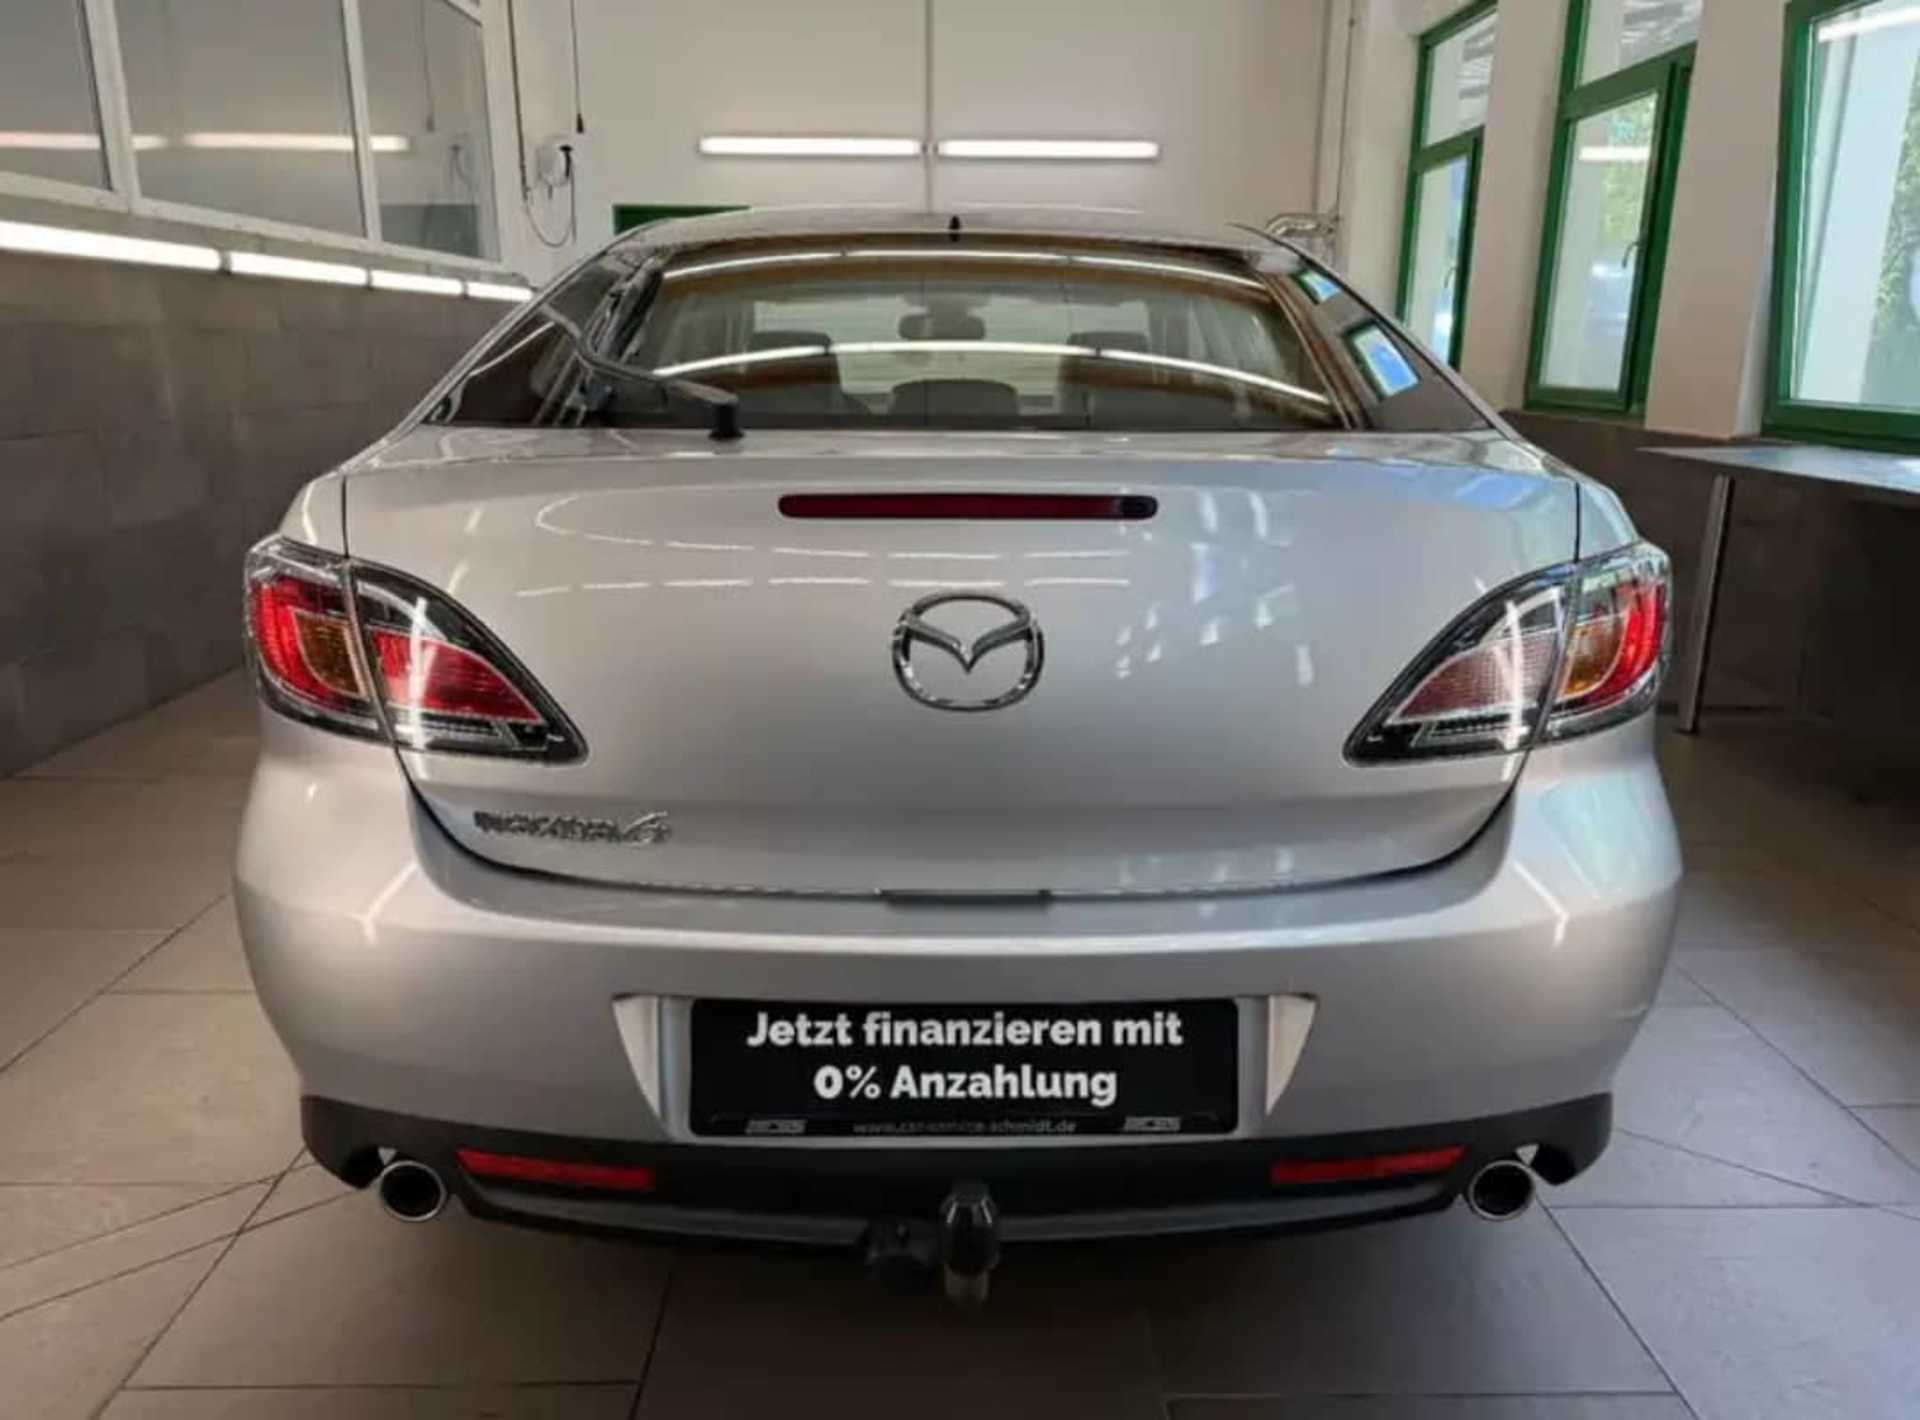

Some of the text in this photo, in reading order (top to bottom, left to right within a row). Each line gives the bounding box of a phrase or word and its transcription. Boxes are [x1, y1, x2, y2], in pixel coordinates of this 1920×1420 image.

[746, 1011, 1183, 1046] Jetzt finanzieren mit
[813, 1063, 1117, 1108] 0% Anzahlung
